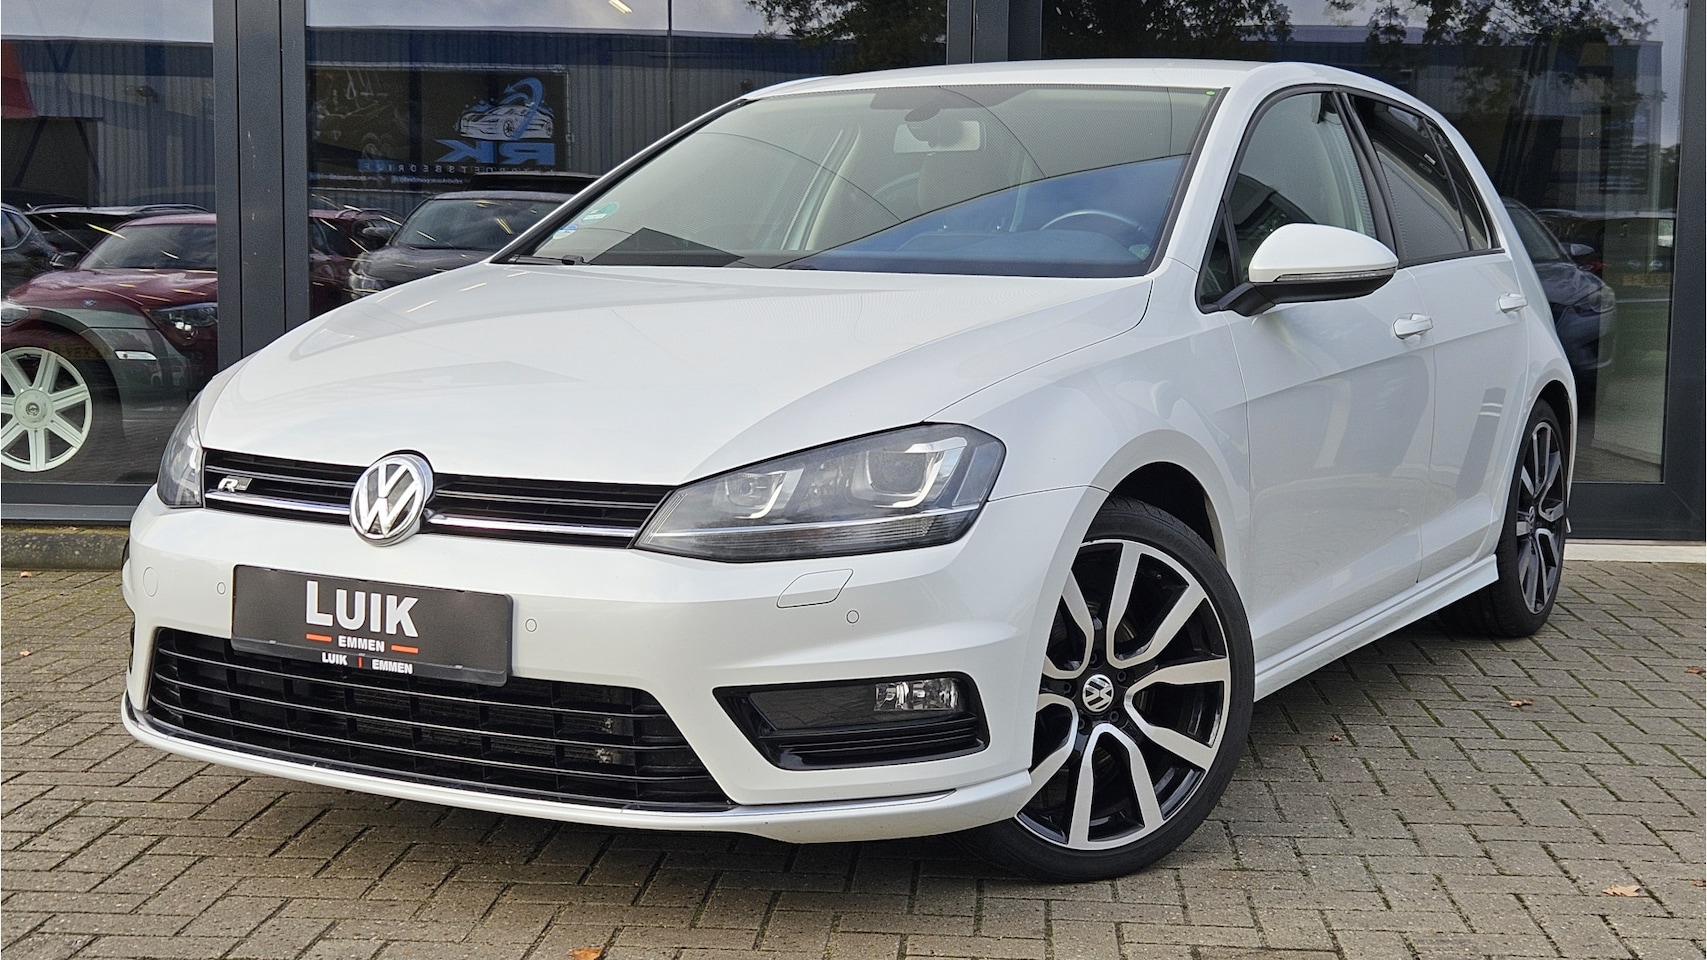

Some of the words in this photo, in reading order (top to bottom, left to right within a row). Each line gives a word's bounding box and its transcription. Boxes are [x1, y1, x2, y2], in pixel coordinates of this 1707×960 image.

[305, 580, 419, 638] LUIK
[337, 635, 385, 653] EMMEN
[321, 652, 348, 666] LUIK
[371, 659, 414, 675] EMMEN
